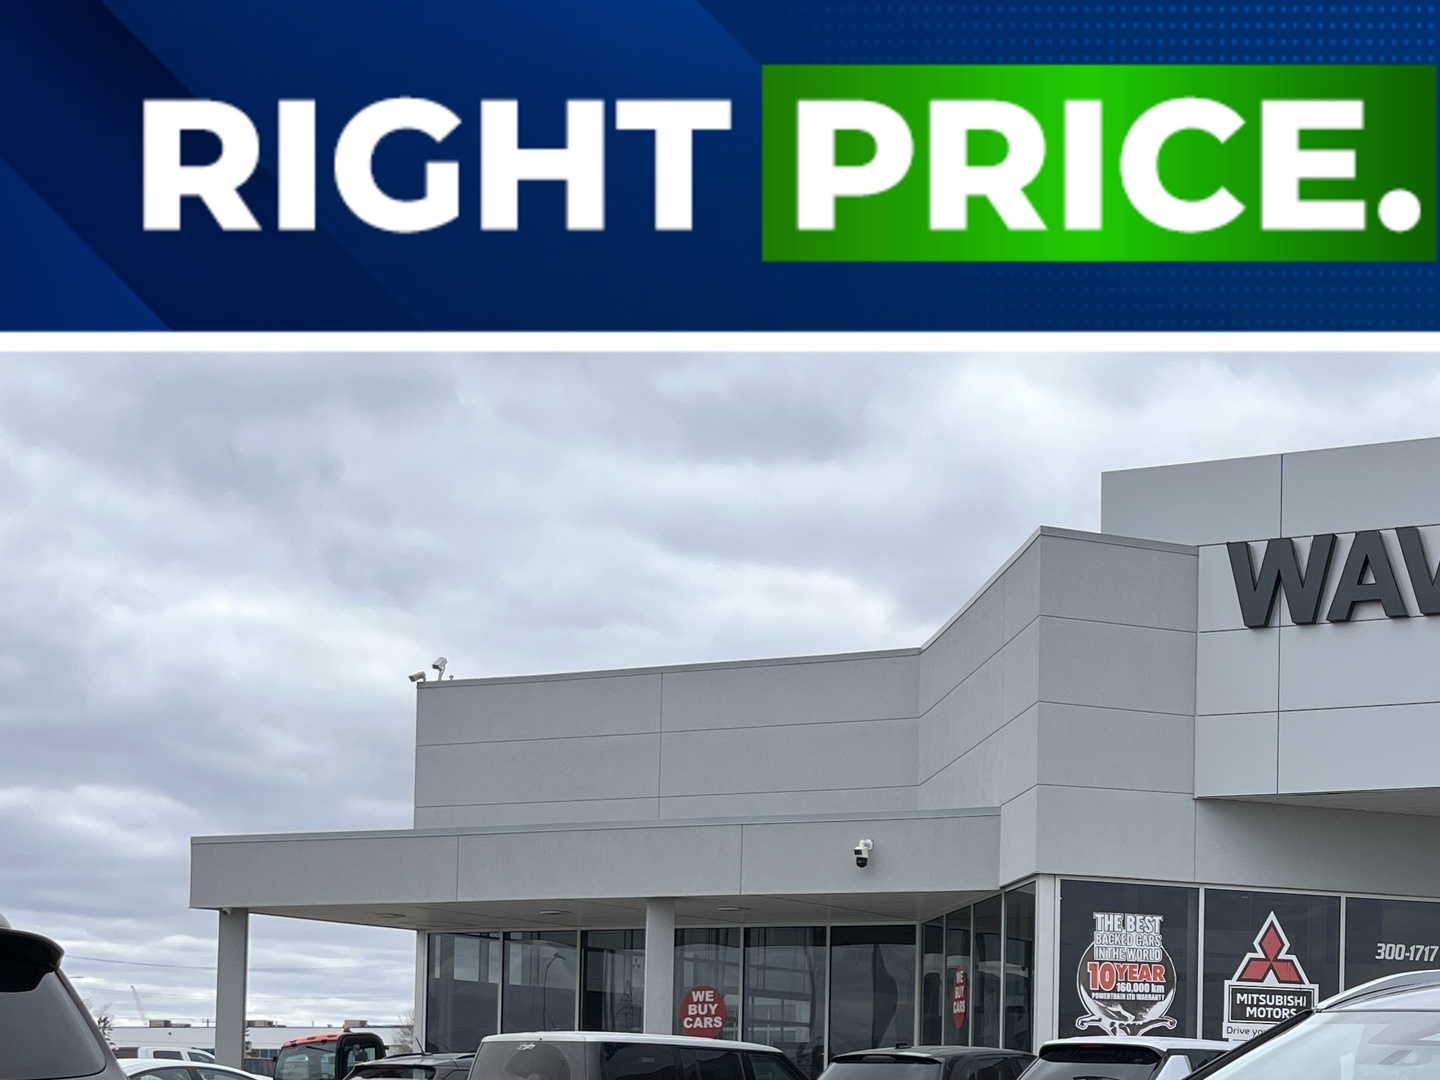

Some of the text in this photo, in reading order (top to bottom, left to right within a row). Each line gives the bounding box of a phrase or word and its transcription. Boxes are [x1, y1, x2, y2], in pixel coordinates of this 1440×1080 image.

[1094, 913, 1163, 934] THE BEST
[1095, 933, 1162, 947] BACKED CARS
[1106, 947, 1126, 960] THE
[1127, 948, 1162, 961] WORLD
[1375, 943, 1439, 962] 300-1717
[1087, 962, 1166, 991] 10 YEAR
[1116, 982, 1165, 994] 160,000 km
[692, 990, 714, 1002] WE
[1236, 993, 1307, 1007] MITSUBISHI
[688, 1003, 719, 1015] BUY
[1246, 1006, 1297, 1019] MOTORS
[683, 1016, 723, 1028] CARS
[1226, 1026, 1250, 1035] Drive
